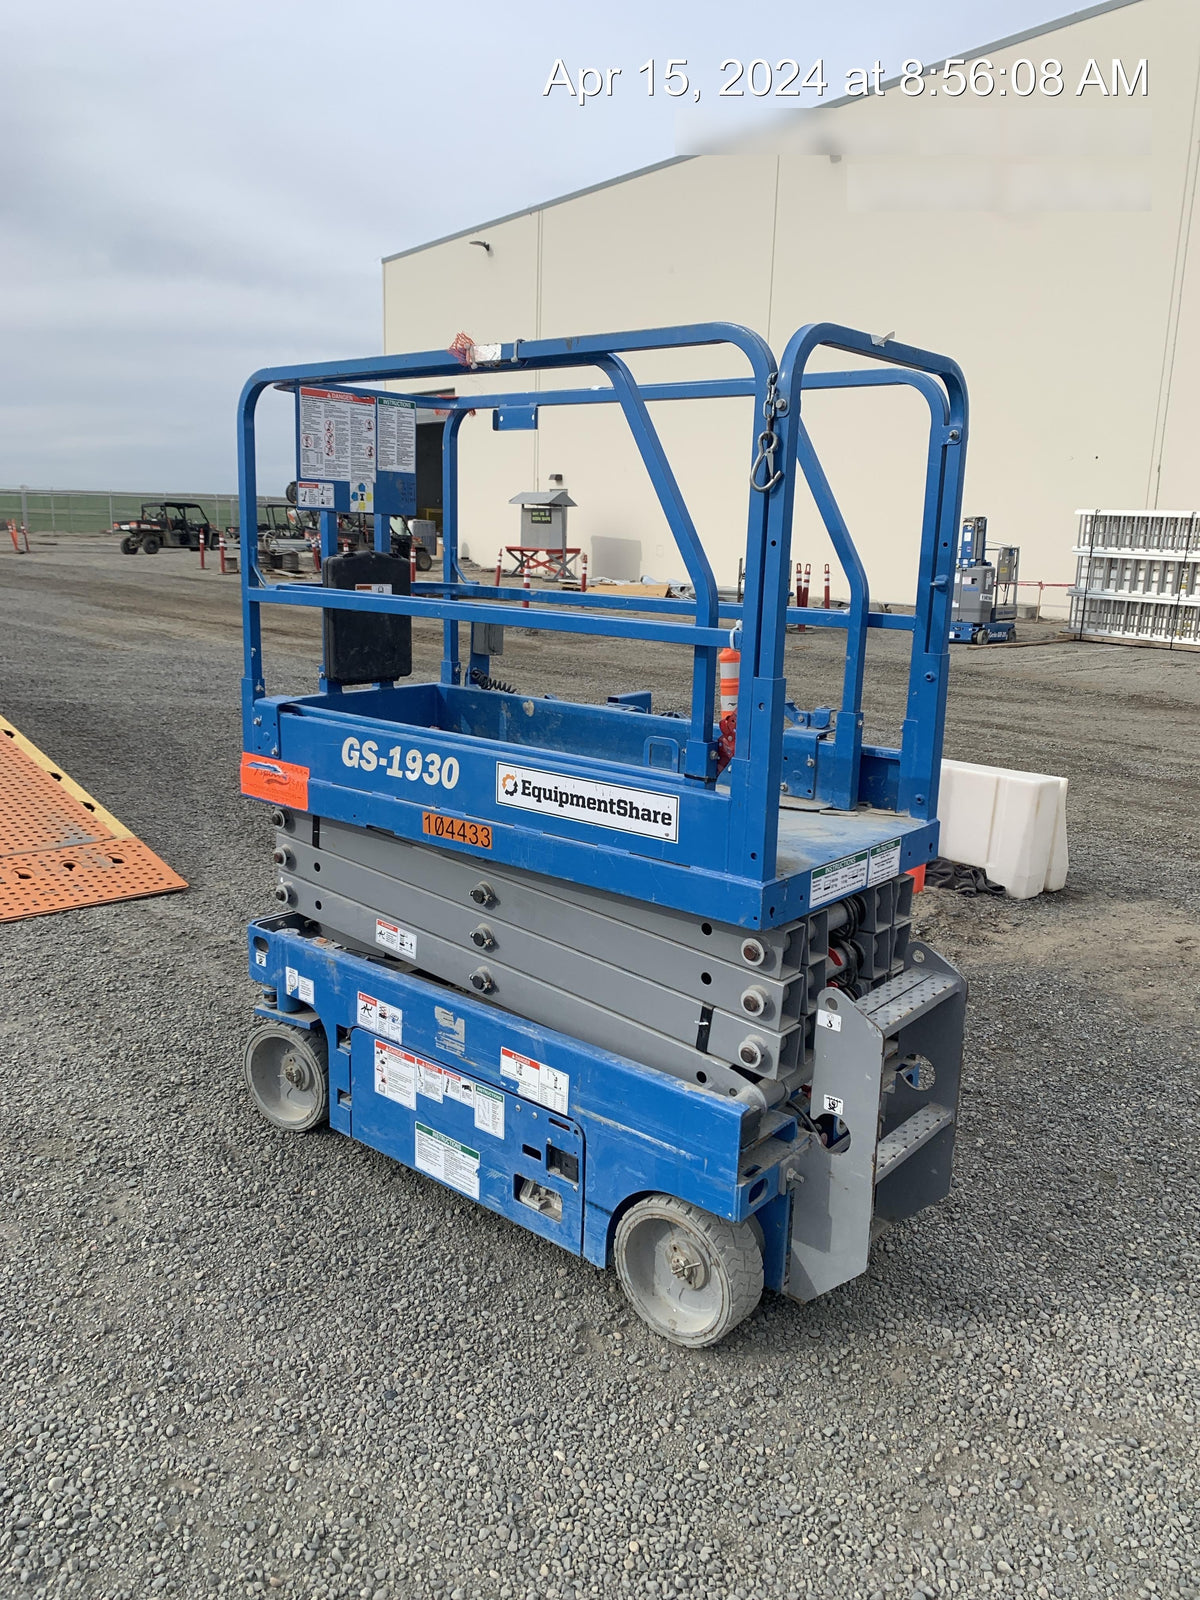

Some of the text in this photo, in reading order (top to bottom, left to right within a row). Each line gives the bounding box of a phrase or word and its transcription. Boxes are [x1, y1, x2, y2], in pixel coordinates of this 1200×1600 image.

[341, 736, 460, 790] GS-1930
[520, 779, 673, 828] EquipmentShare
[423, 813, 492, 849] 104433
[825, 857, 856, 874] INSTRUCTIONS
